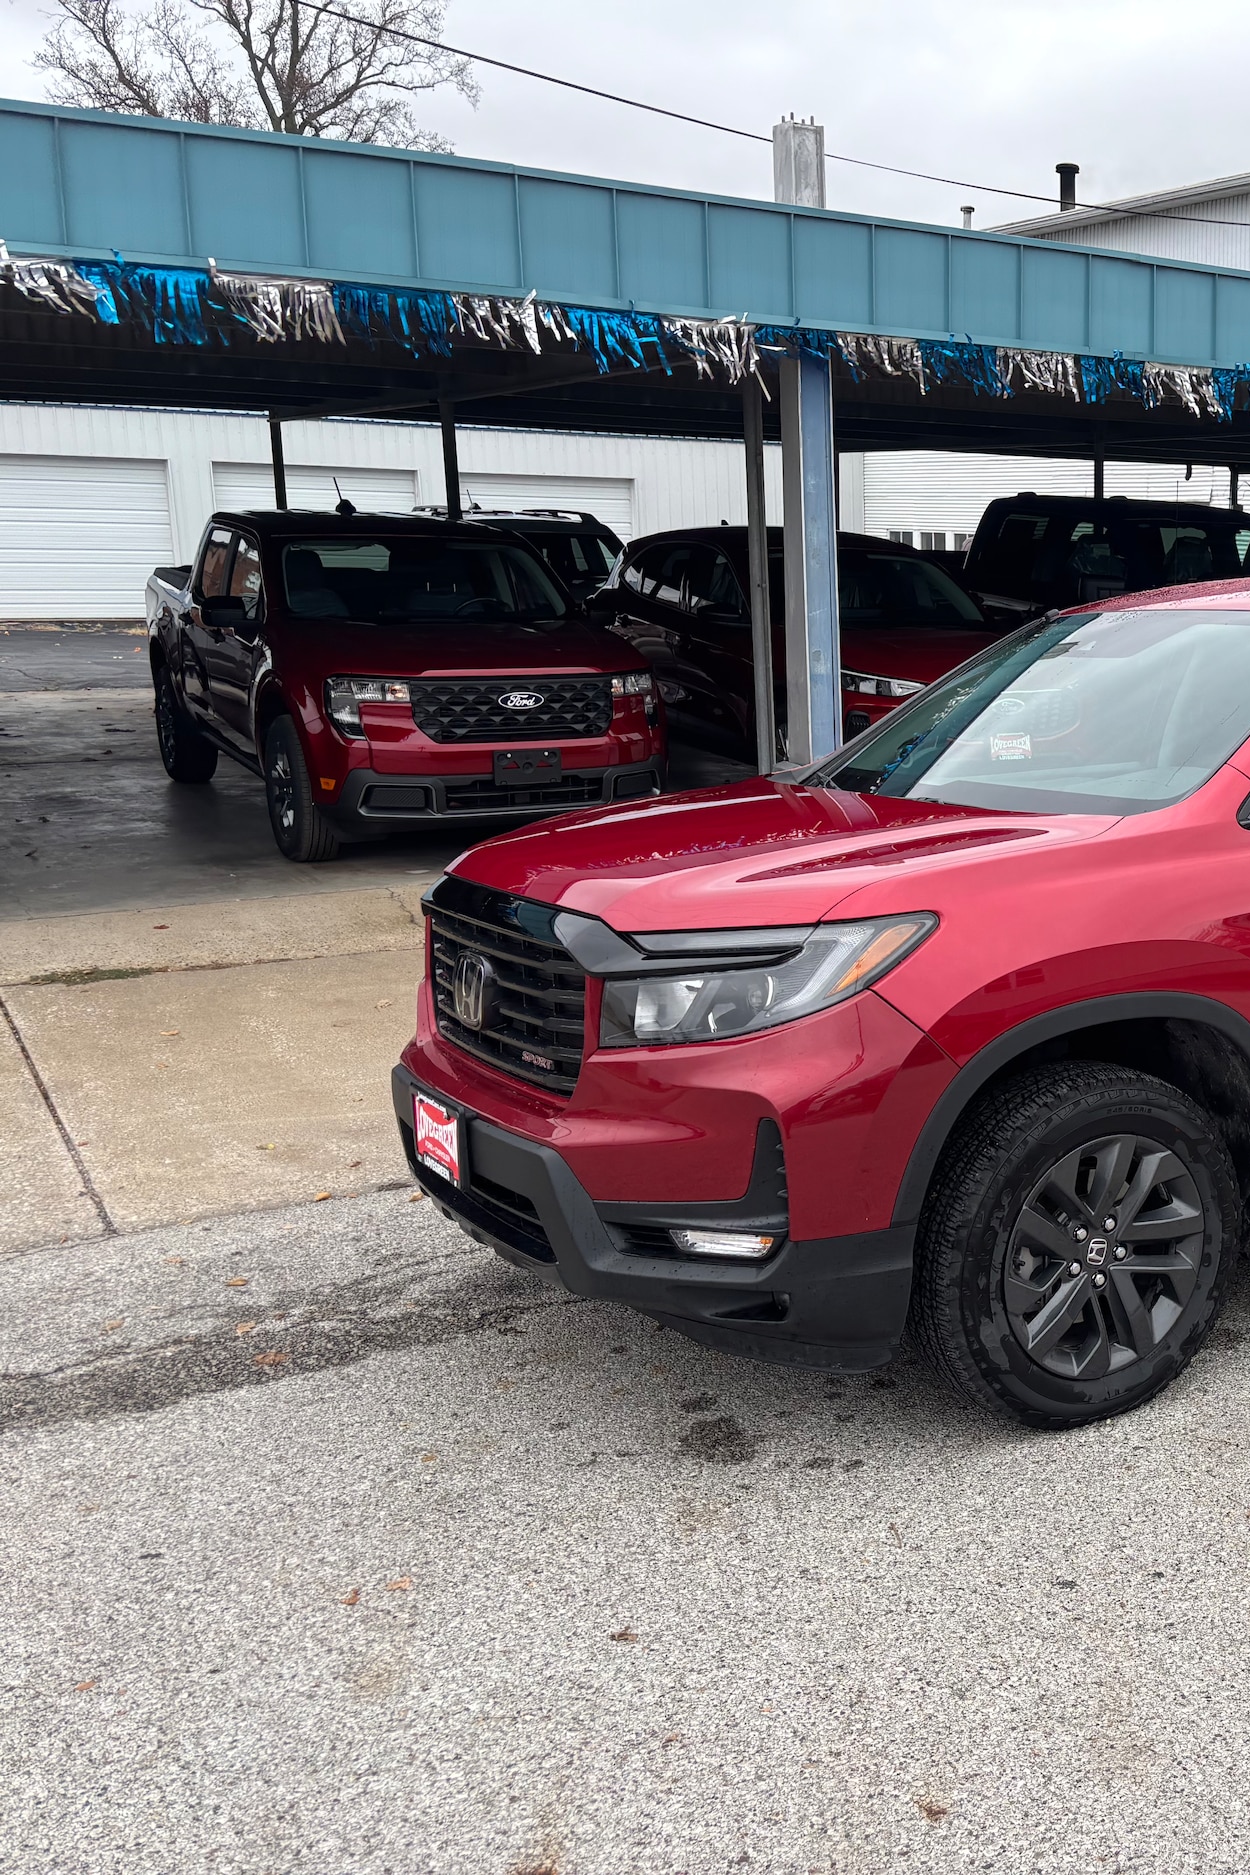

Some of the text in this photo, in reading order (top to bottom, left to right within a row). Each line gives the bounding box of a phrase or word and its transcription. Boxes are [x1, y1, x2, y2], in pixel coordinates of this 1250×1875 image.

[507, 694, 536, 706] Ford
[990, 734, 1031, 754] LOVEGREEN
[521, 1050, 554, 1070] SPORT
[417, 1104, 459, 1168] LOVEGREEN
[423, 1153, 450, 1182] LOVEGREEN
